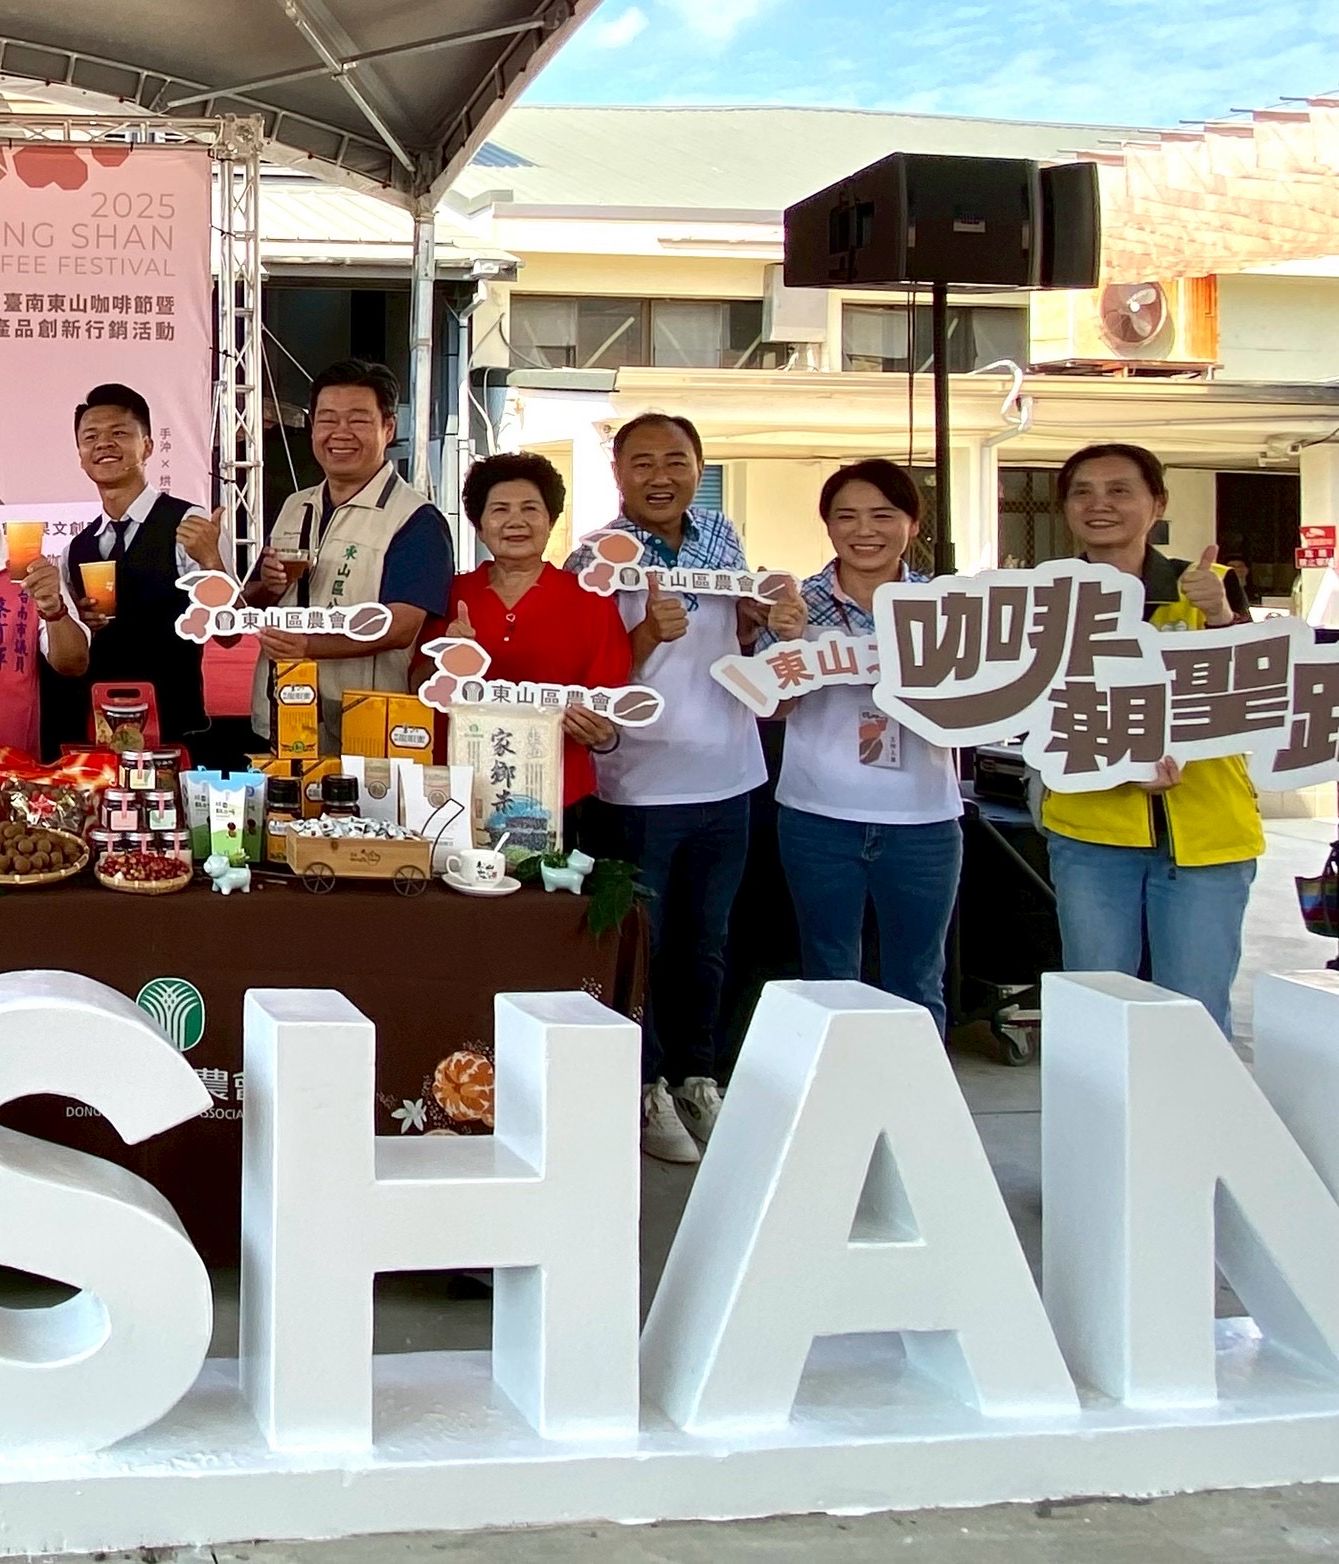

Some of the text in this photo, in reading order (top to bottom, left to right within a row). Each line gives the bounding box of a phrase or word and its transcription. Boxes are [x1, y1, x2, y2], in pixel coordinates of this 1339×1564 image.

[90, 192, 176, 219] 2025
[71, 223, 174, 251] SHAN
[58, 256, 176, 277] FESTIVAL
[241, 611, 347, 629] 東山區農會
[892, 576, 1144, 730] 咖啡
[491, 685, 611, 711] 東山區農會
